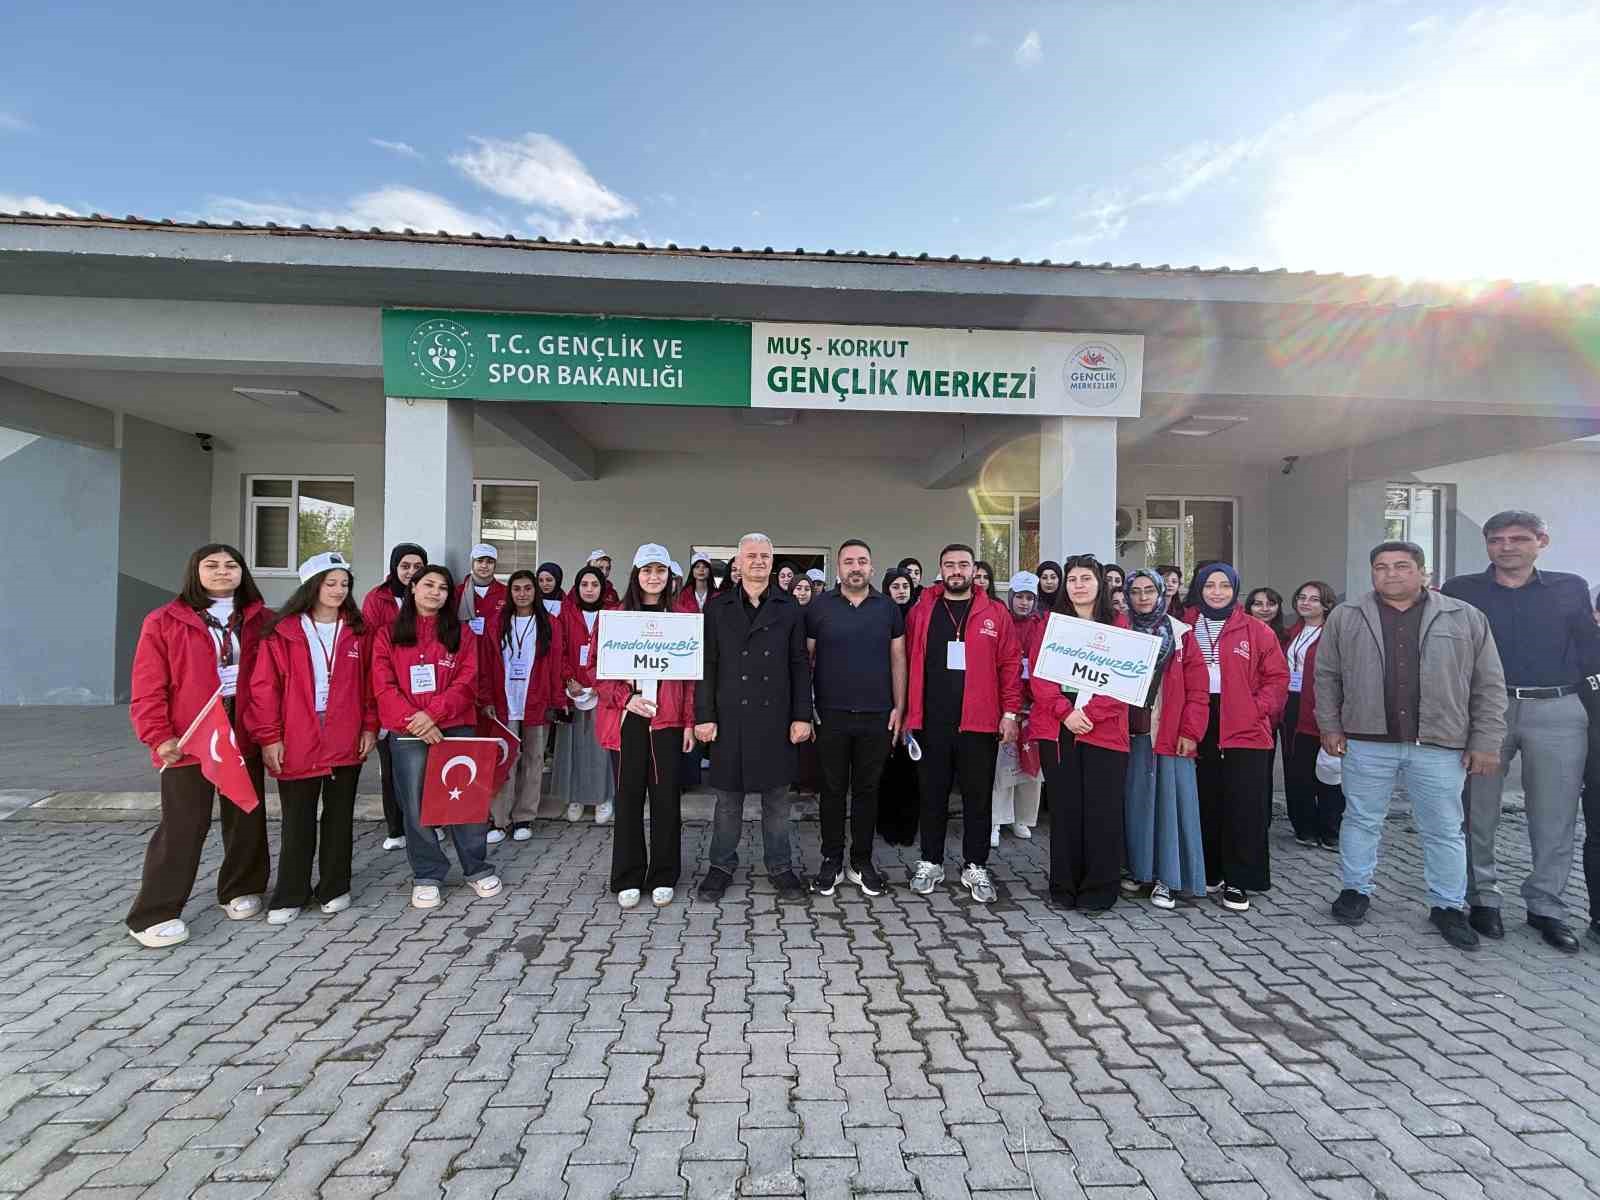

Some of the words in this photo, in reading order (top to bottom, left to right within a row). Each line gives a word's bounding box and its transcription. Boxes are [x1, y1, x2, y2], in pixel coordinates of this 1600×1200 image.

[487, 334, 530, 354] T.C.
[538, 334, 644, 362] GENÇLİK
[653, 338, 683, 359] VE
[767, 336, 812, 360] MUŞ
[828, 338, 909, 358] KORKUT
[488, 363, 550, 385] SPOR
[557, 364, 683, 388] BAKANLIĞI
[767, 361, 898, 402] GENÇLİK
[906, 366, 1036, 399] MERKEZİ
[633, 654, 669, 672] Muş
[1072, 662, 1110, 687] Muş
